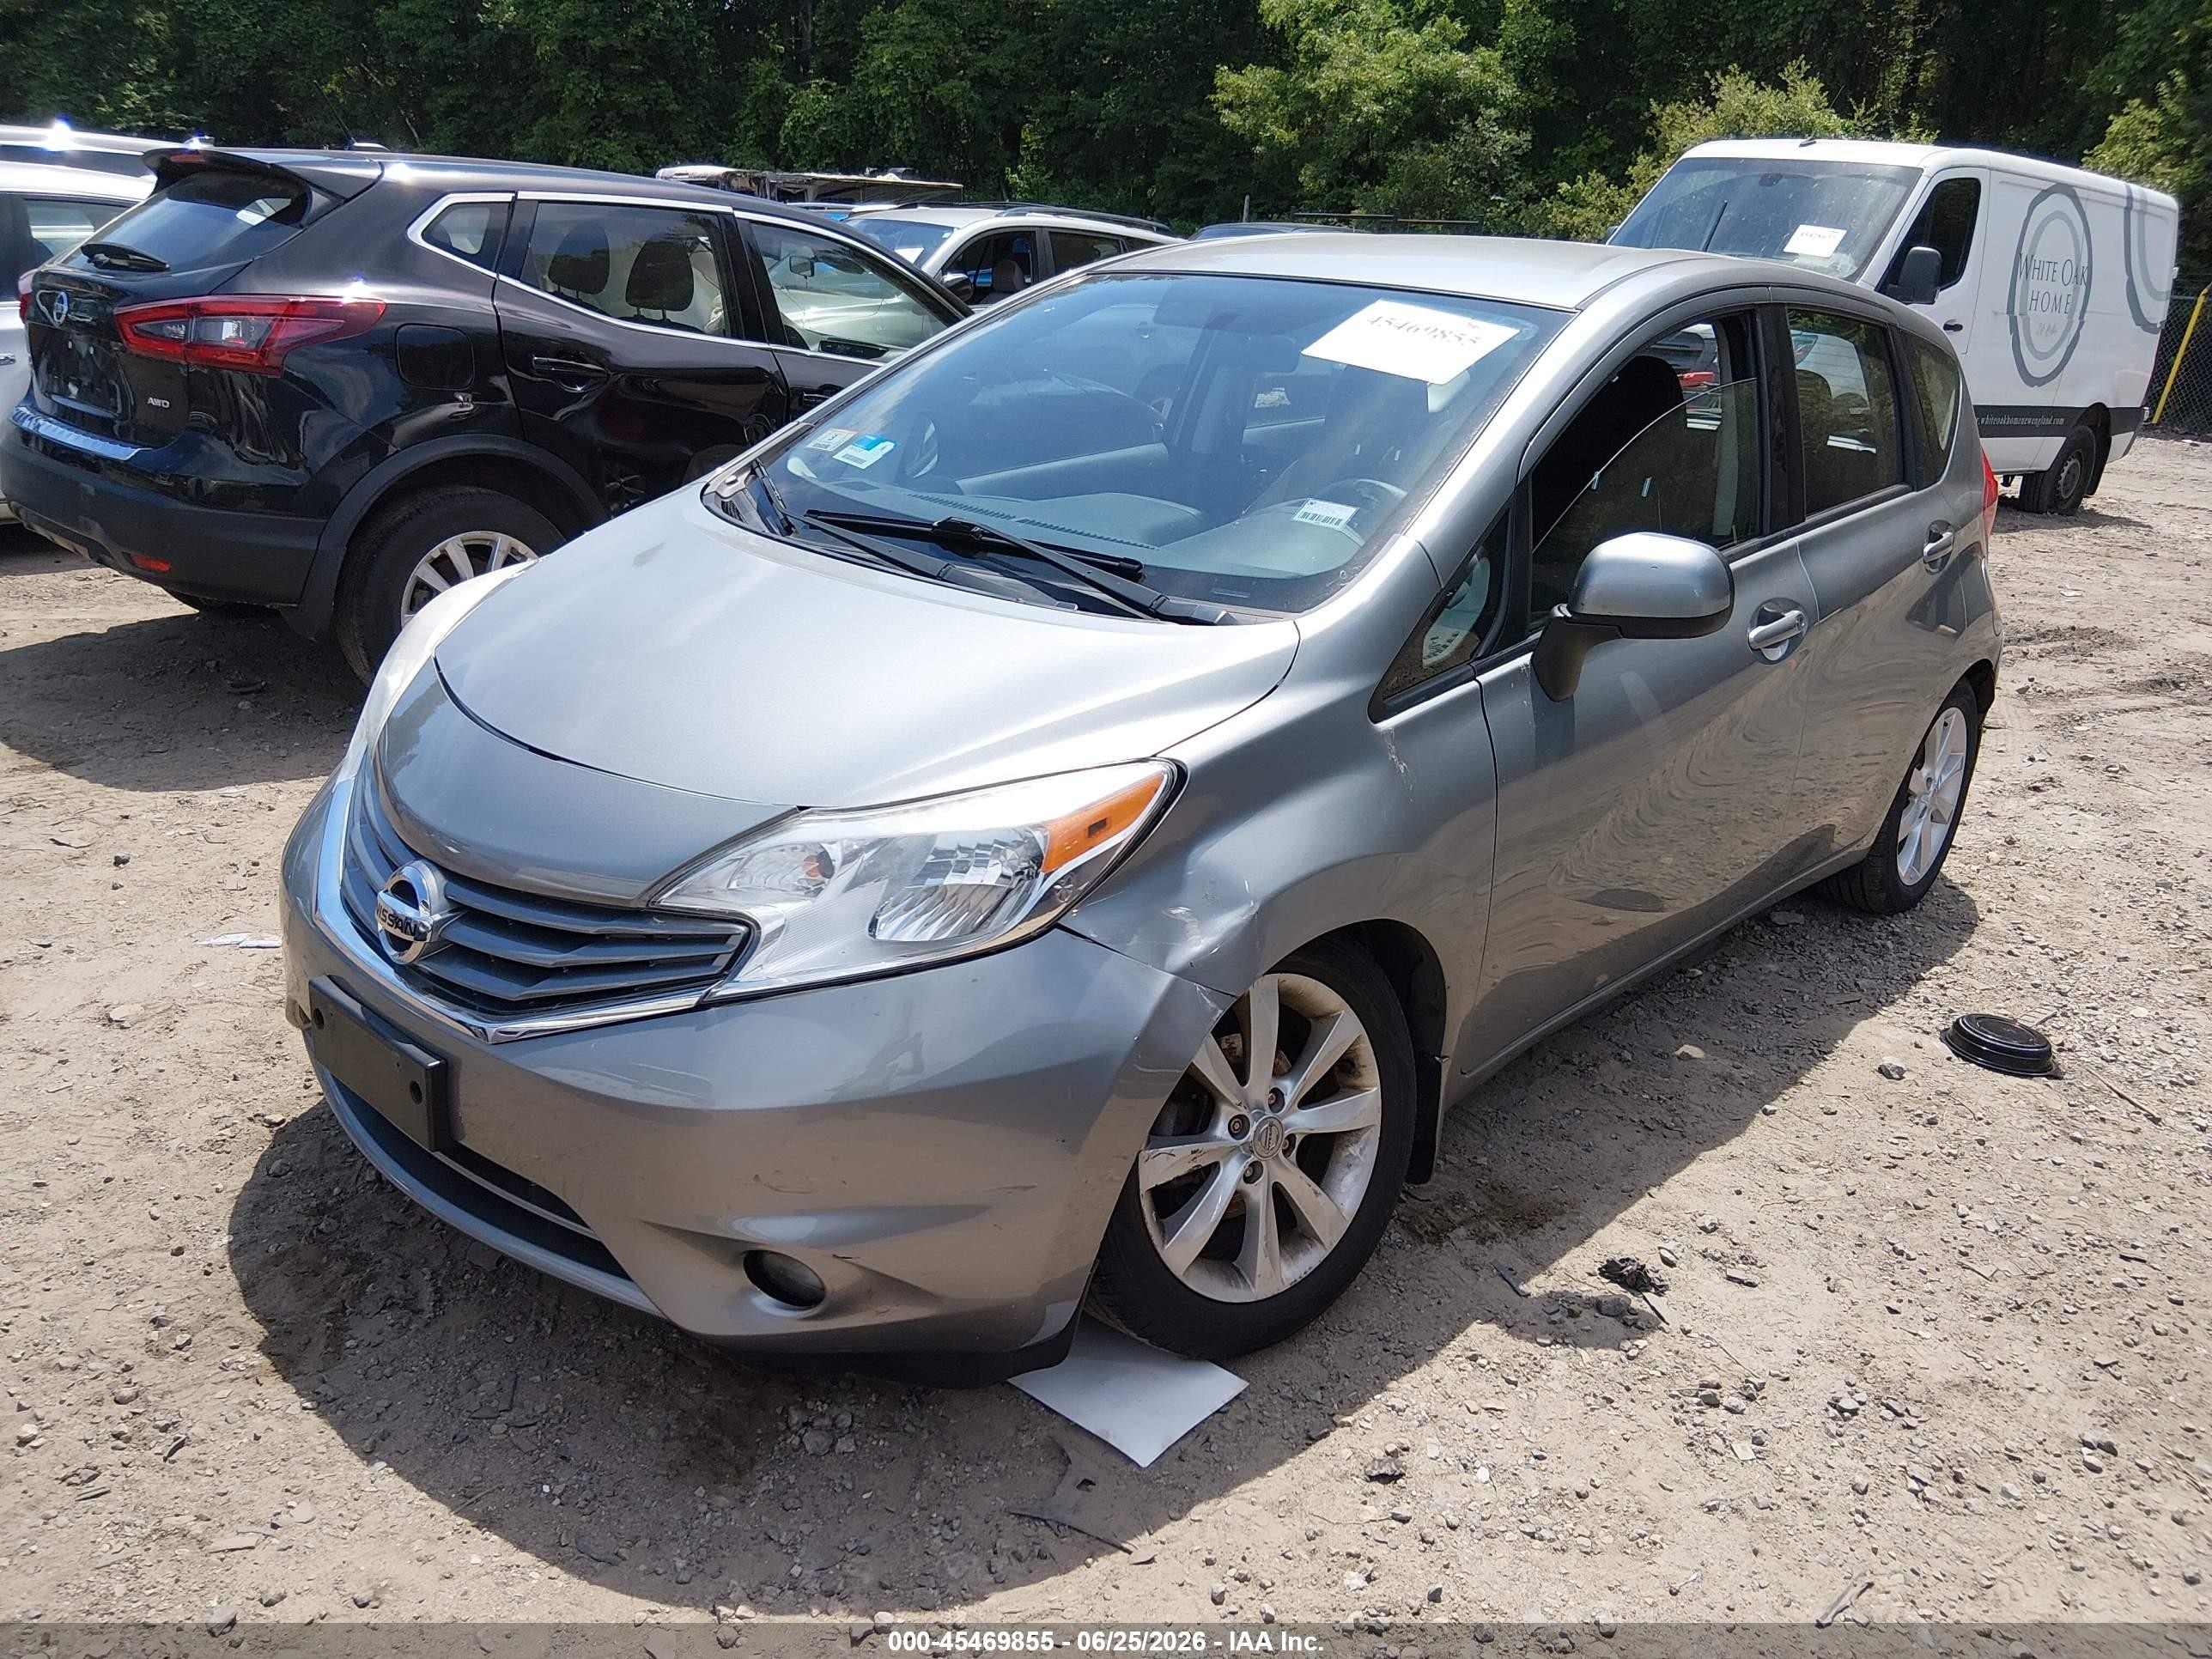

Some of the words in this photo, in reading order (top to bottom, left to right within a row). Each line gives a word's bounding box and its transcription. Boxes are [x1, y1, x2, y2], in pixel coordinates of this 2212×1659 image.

[2019, 252, 2058, 283] WHITE
[2061, 258, 2088, 287] OAK
[2028, 289, 2072, 314] HOME
[147, 397, 170, 409] AWD
